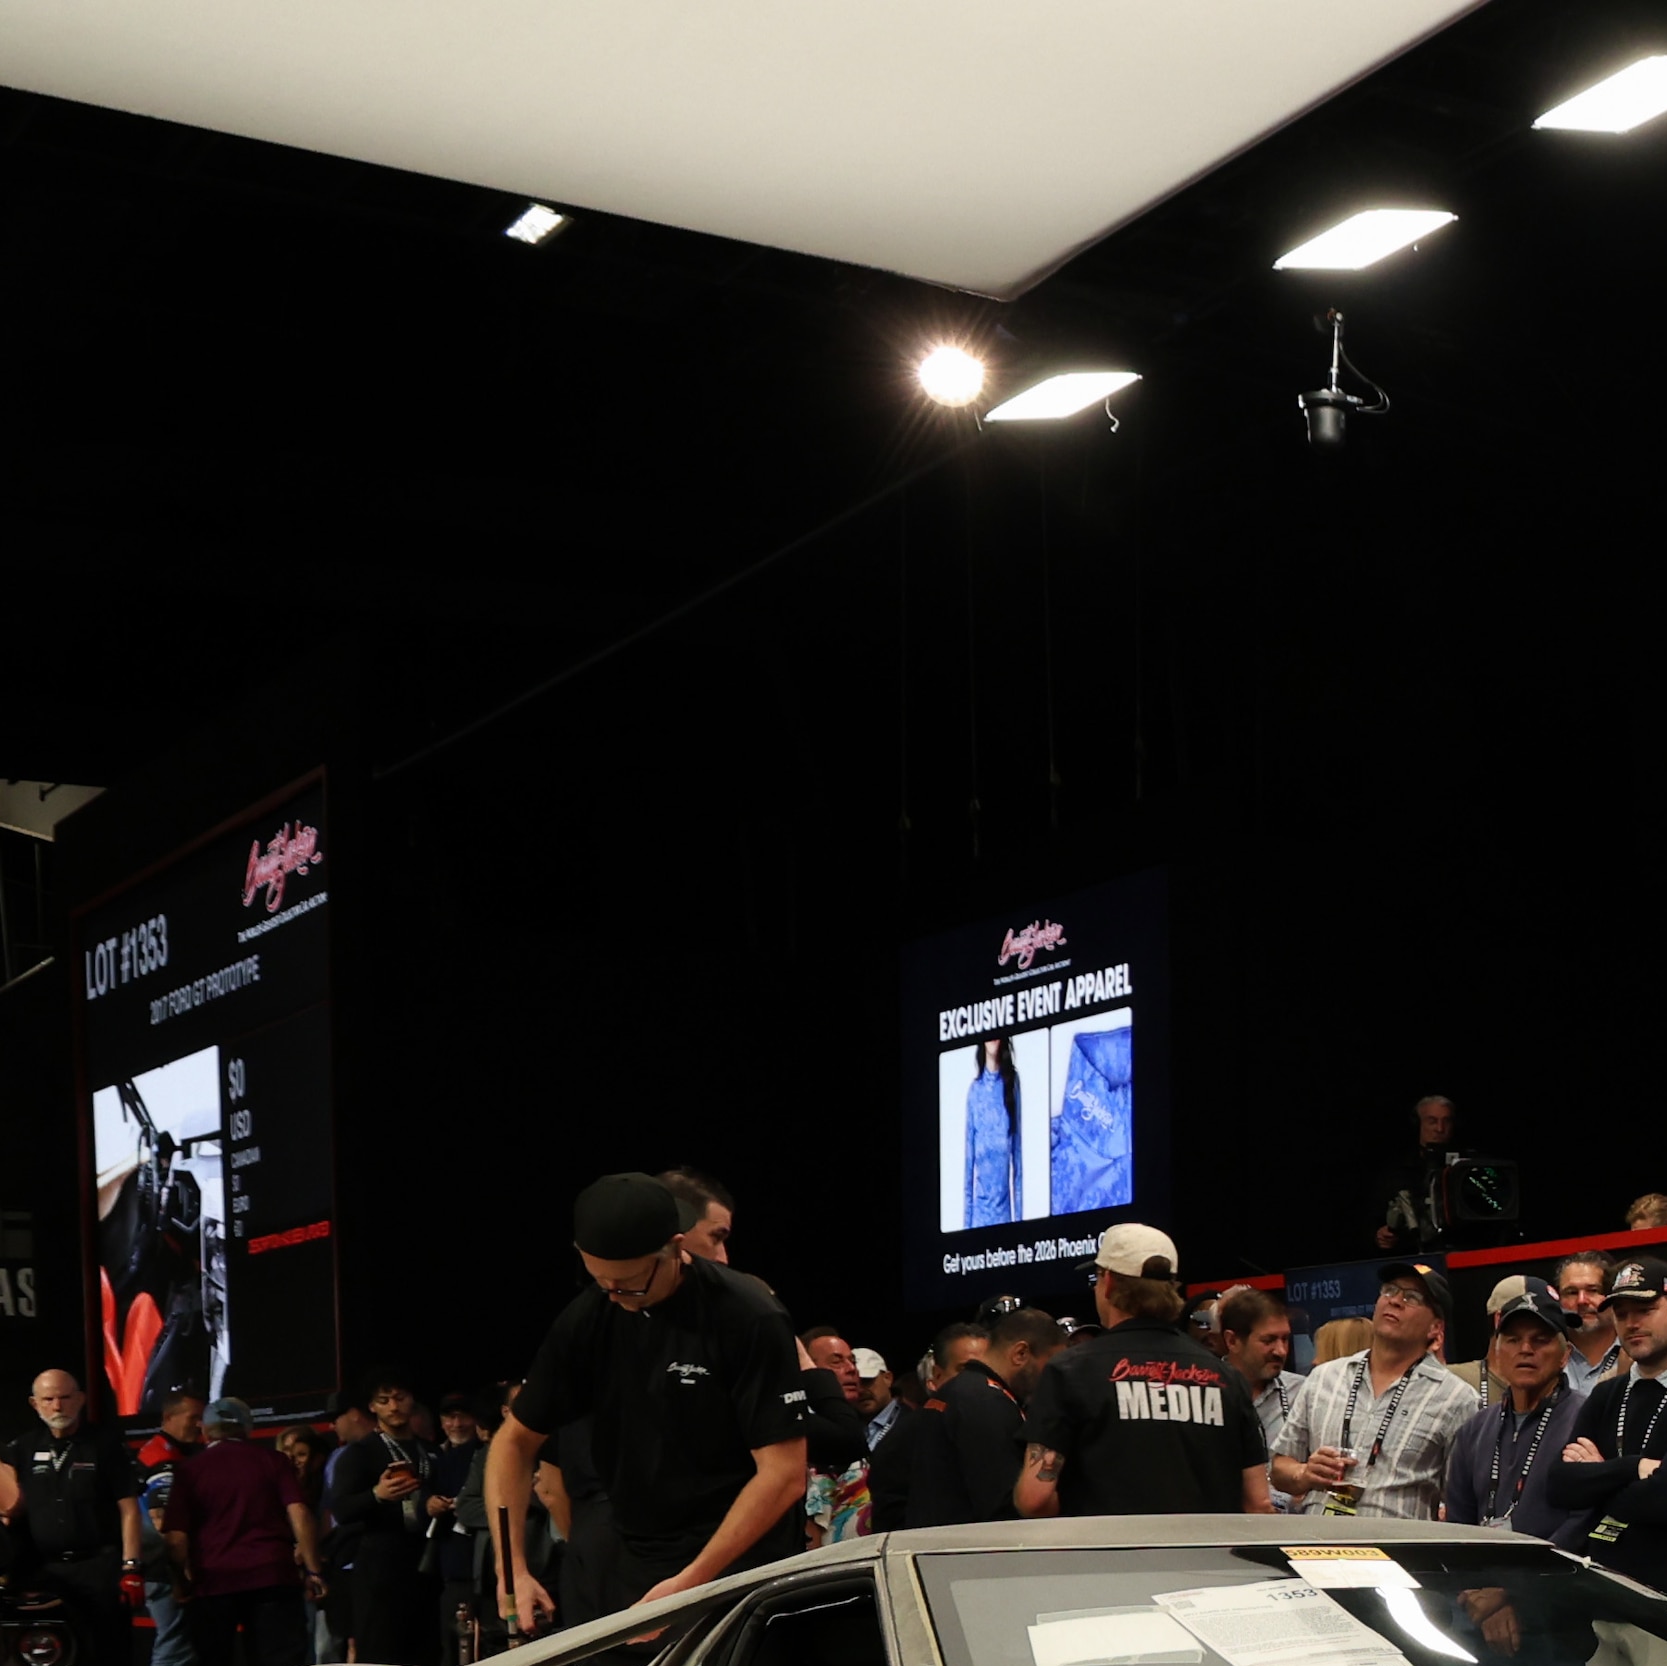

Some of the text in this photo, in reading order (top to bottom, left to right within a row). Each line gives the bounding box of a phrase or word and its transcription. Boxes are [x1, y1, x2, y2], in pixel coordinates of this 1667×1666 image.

[85, 936, 118, 1000] LOT
[120, 913, 168, 984] #1353
[939, 994, 1015, 1042] EXCLUSIVE
[1017, 981, 1063, 1023] EVENT
[1064, 963, 1133, 1011] APPAREL
[229, 1109, 251, 1141] USD
[943, 1253, 961, 1275] Get
[962, 1253, 986, 1276] yours
[986, 1248, 1016, 1269] before
[1018, 1243, 1033, 1264] the
[1034, 1239, 1057, 1262] 2026
[1058, 1234, 1097, 1259] Phoenix
[1286, 1280, 1342, 1303] LOT #1353
[1115, 1380, 1225, 1427] MEDIA
[1285, 1549, 1380, 1557] 589W003
[1266, 1588, 1319, 1602] 1353
